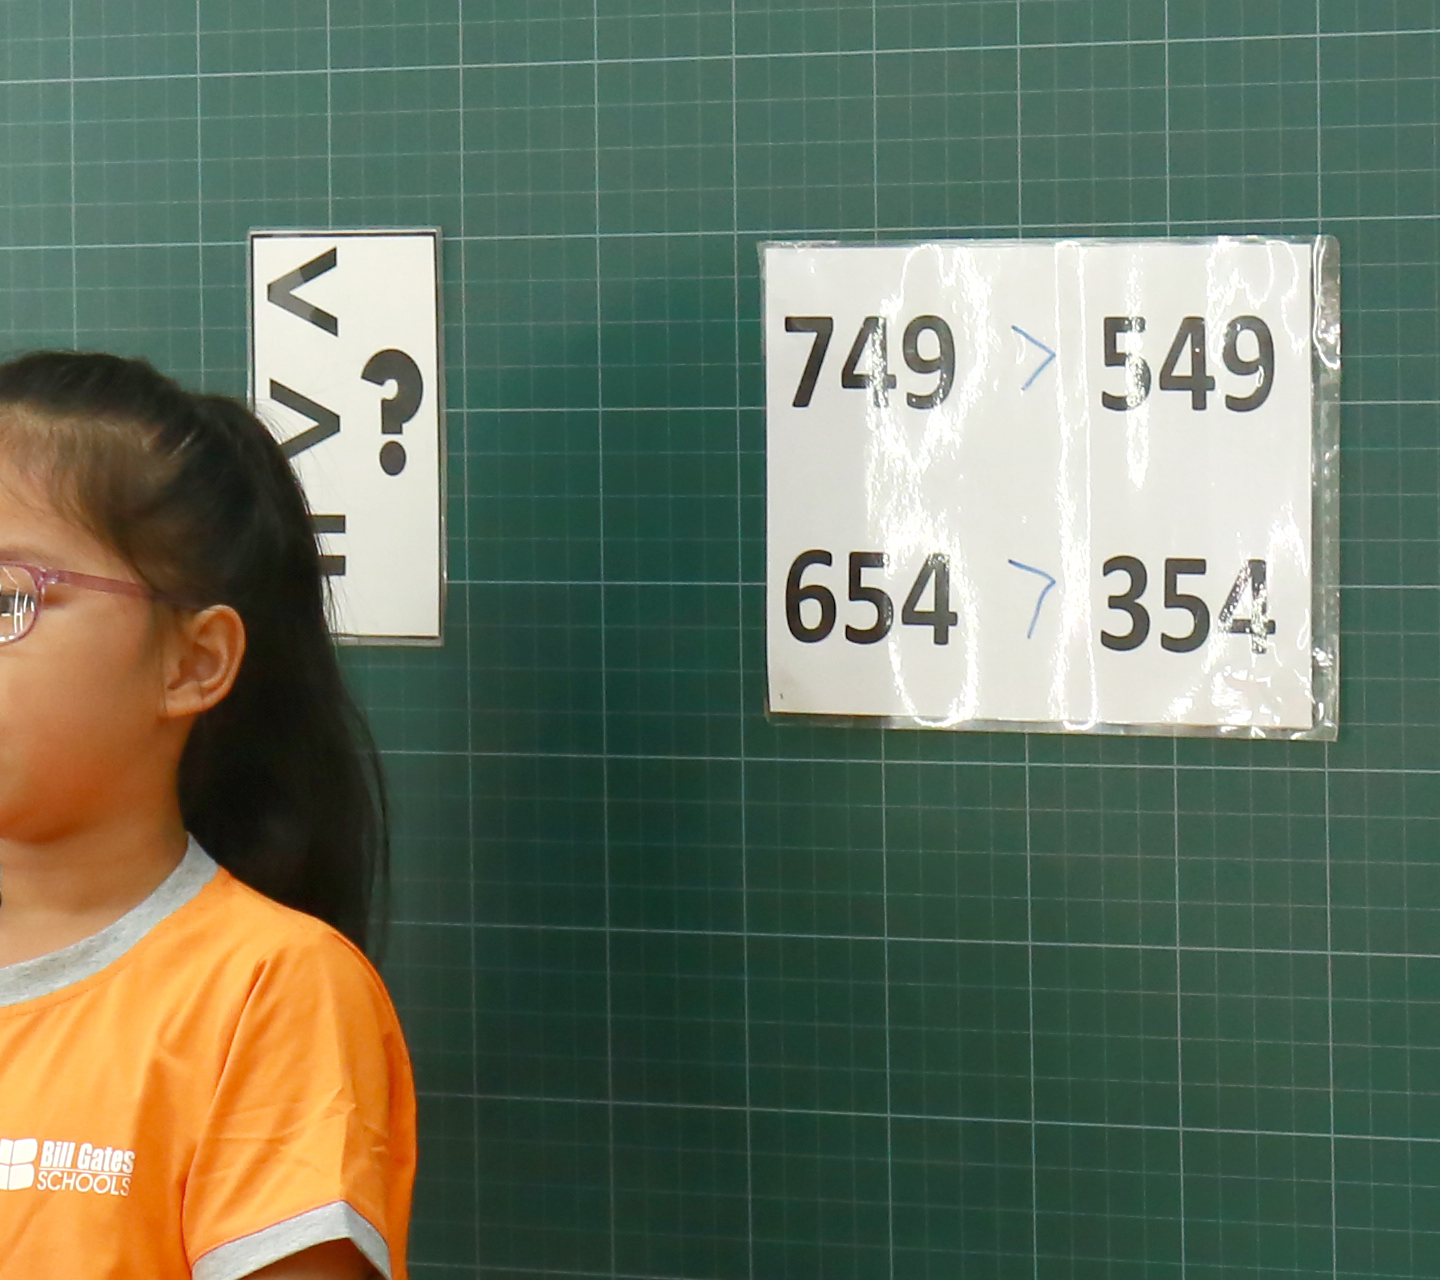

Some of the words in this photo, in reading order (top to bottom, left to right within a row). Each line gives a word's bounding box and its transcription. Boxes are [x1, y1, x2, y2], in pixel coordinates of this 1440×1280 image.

[782, 312, 956, 412] 749
[1099, 315, 1276, 413] 549
[782, 547, 959, 646] 654
[1099, 555, 1278, 655] 354
[38, 1172, 131, 1196] SCHOOLS
[40, 1141, 76, 1168] Bill
[77, 1143, 135, 1172] Gates
